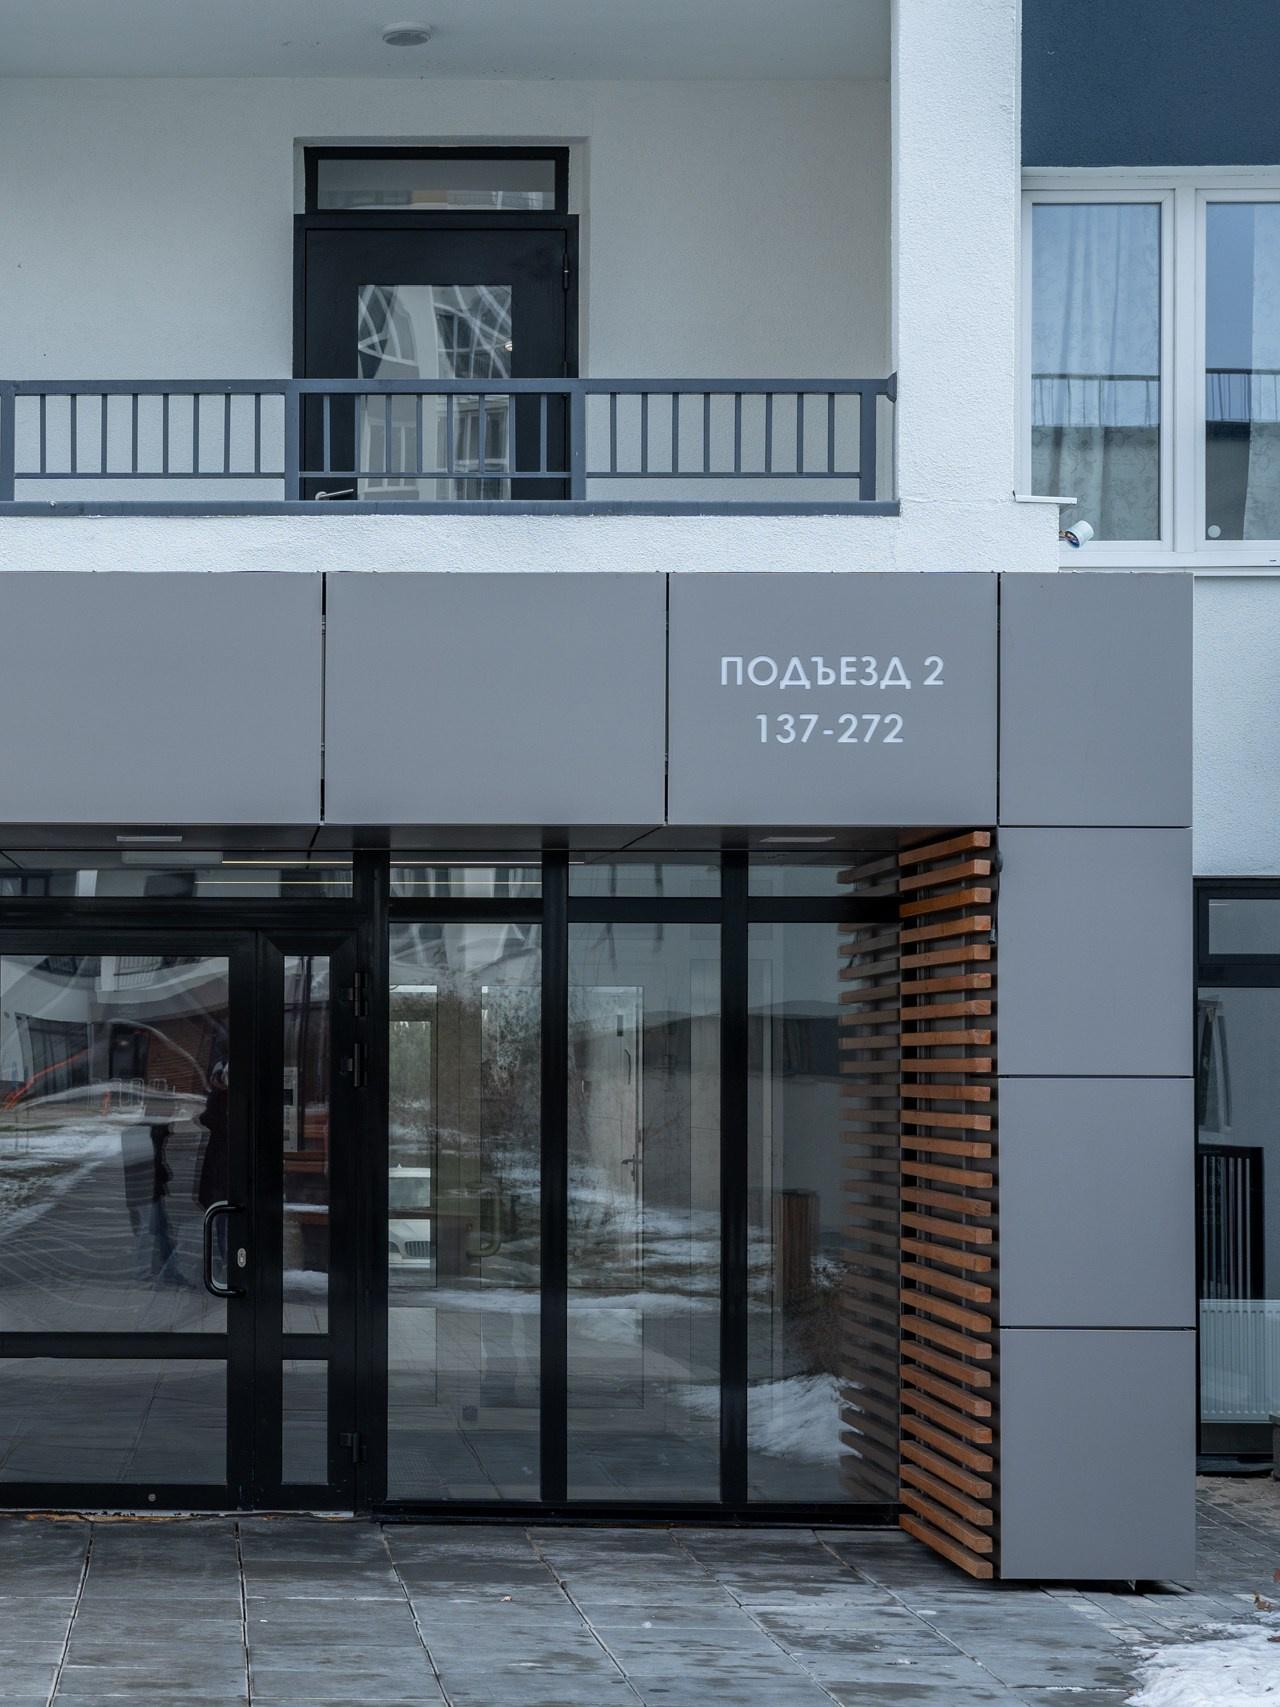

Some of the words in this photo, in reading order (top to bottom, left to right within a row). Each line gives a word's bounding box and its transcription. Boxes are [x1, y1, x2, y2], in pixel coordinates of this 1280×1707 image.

[721, 655, 912, 690] ПОДЪЕЗД
[923, 655, 944, 686] 2
[756, 713, 904, 744] 137-272
